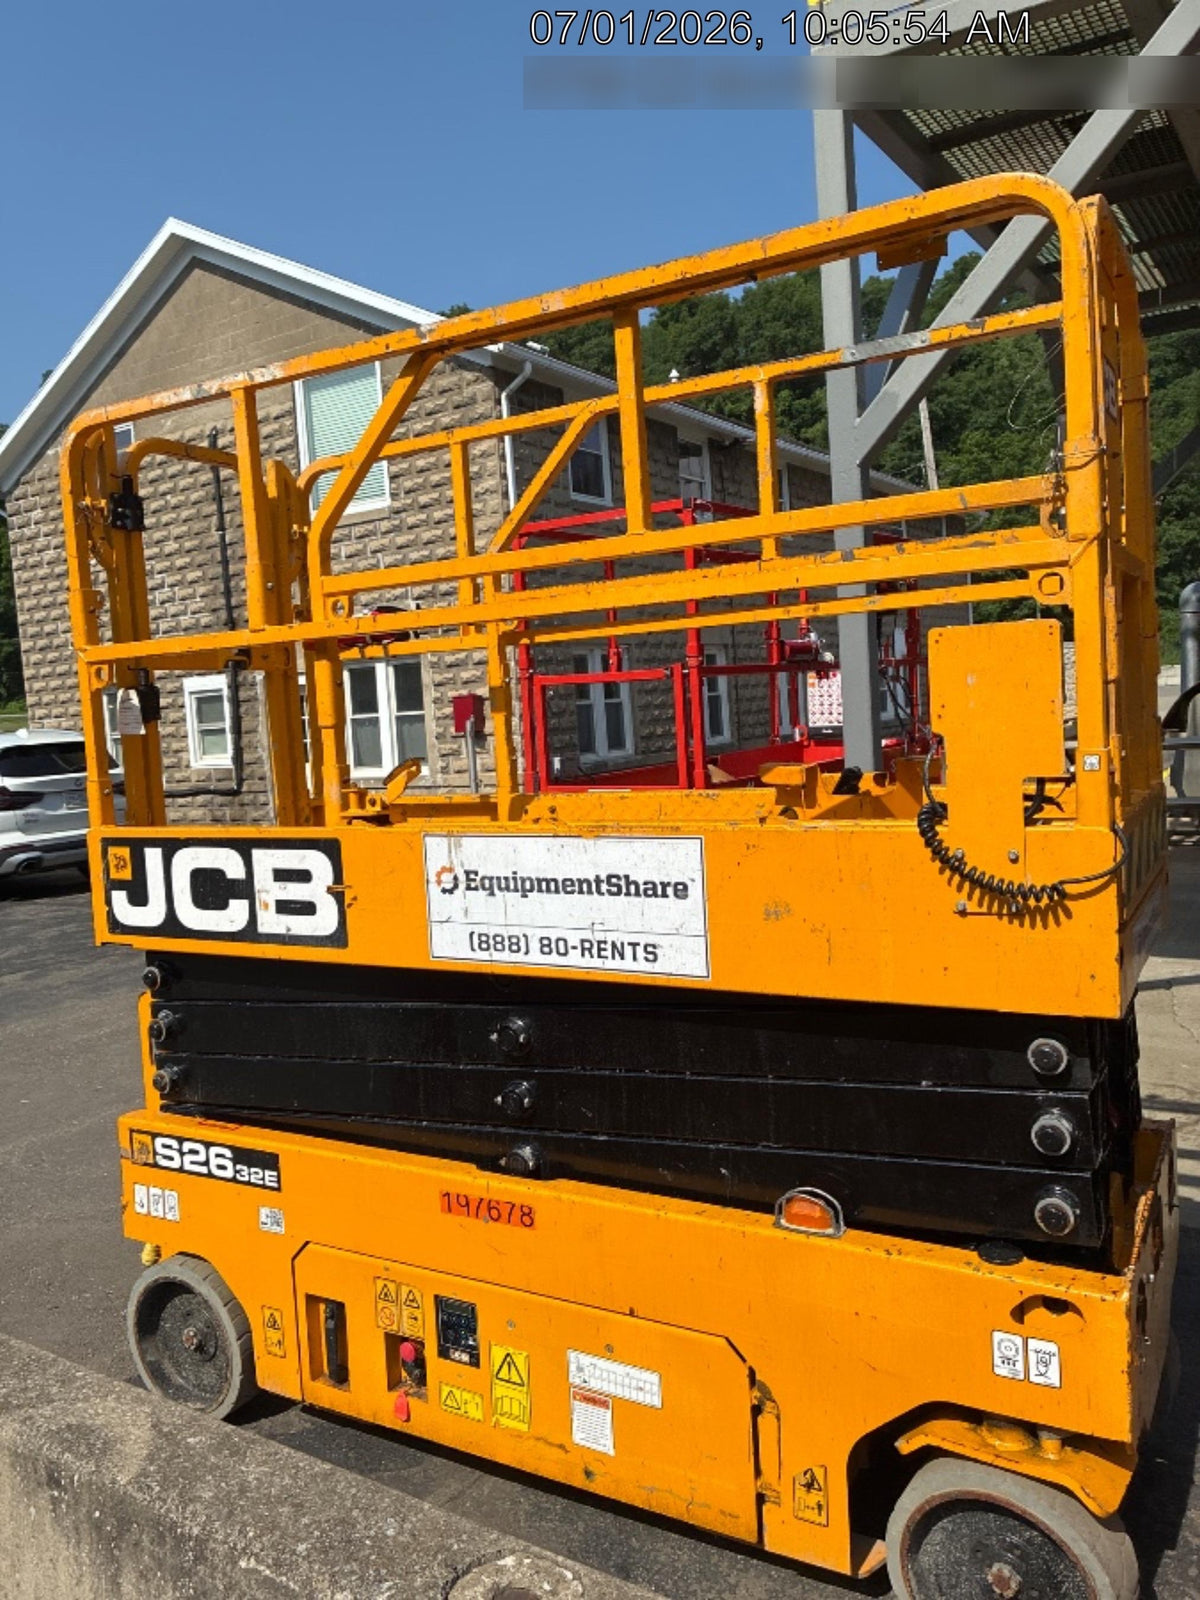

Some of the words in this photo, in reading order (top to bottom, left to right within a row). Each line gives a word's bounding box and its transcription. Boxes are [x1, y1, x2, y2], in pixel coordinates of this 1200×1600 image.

[111, 846, 339, 936] JCB
[463, 869, 689, 899] EquipmentShare
[469, 931, 530, 956] (888)
[539, 936, 659, 963] 80-RENTS
[442, 1192, 535, 1228] 197678
